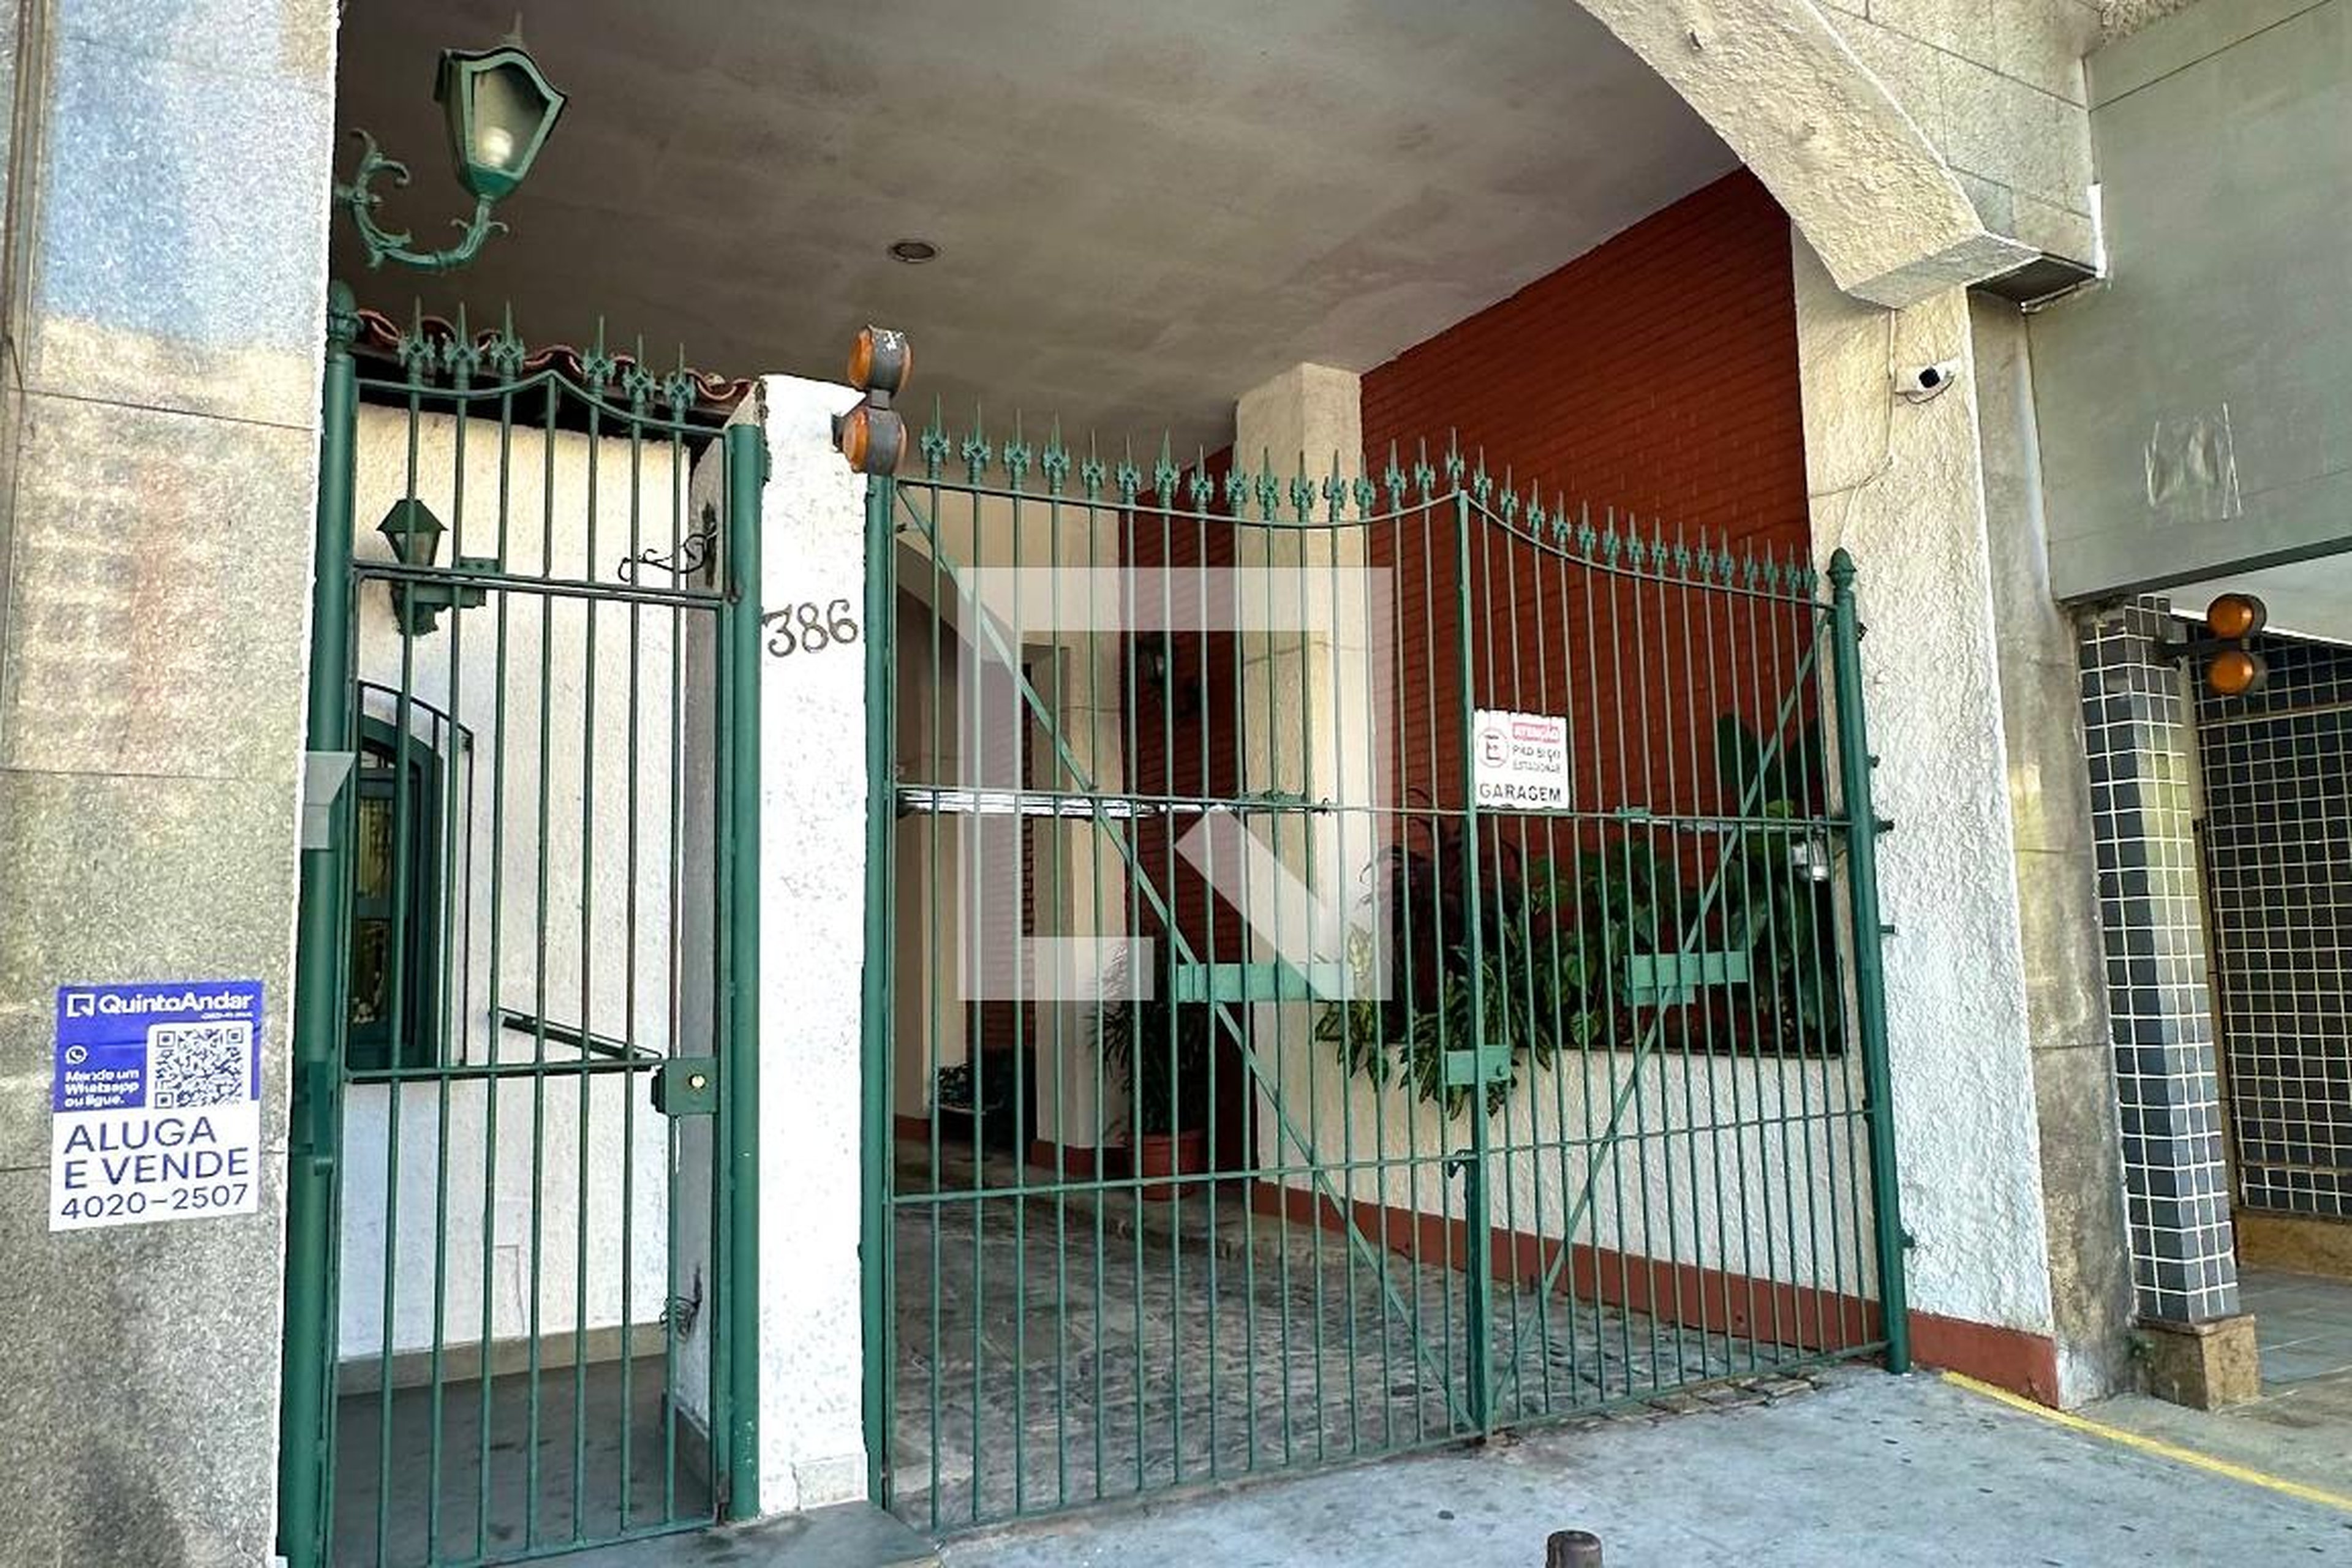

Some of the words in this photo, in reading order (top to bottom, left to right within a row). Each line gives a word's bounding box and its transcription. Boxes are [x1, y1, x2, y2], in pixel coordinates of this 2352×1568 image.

[761, 599, 858, 657] 386
[1479, 783, 1561, 801] GARAGEM
[99, 990, 254, 1014] QuintoAndar
[65, 1098, 84, 1107] ou
[64, 1116, 216, 1154] ALUGA
[65, 1160, 88, 1189] E
[102, 1147, 247, 1185] VENDE
[61, 1183, 247, 1219] 4020-2507
